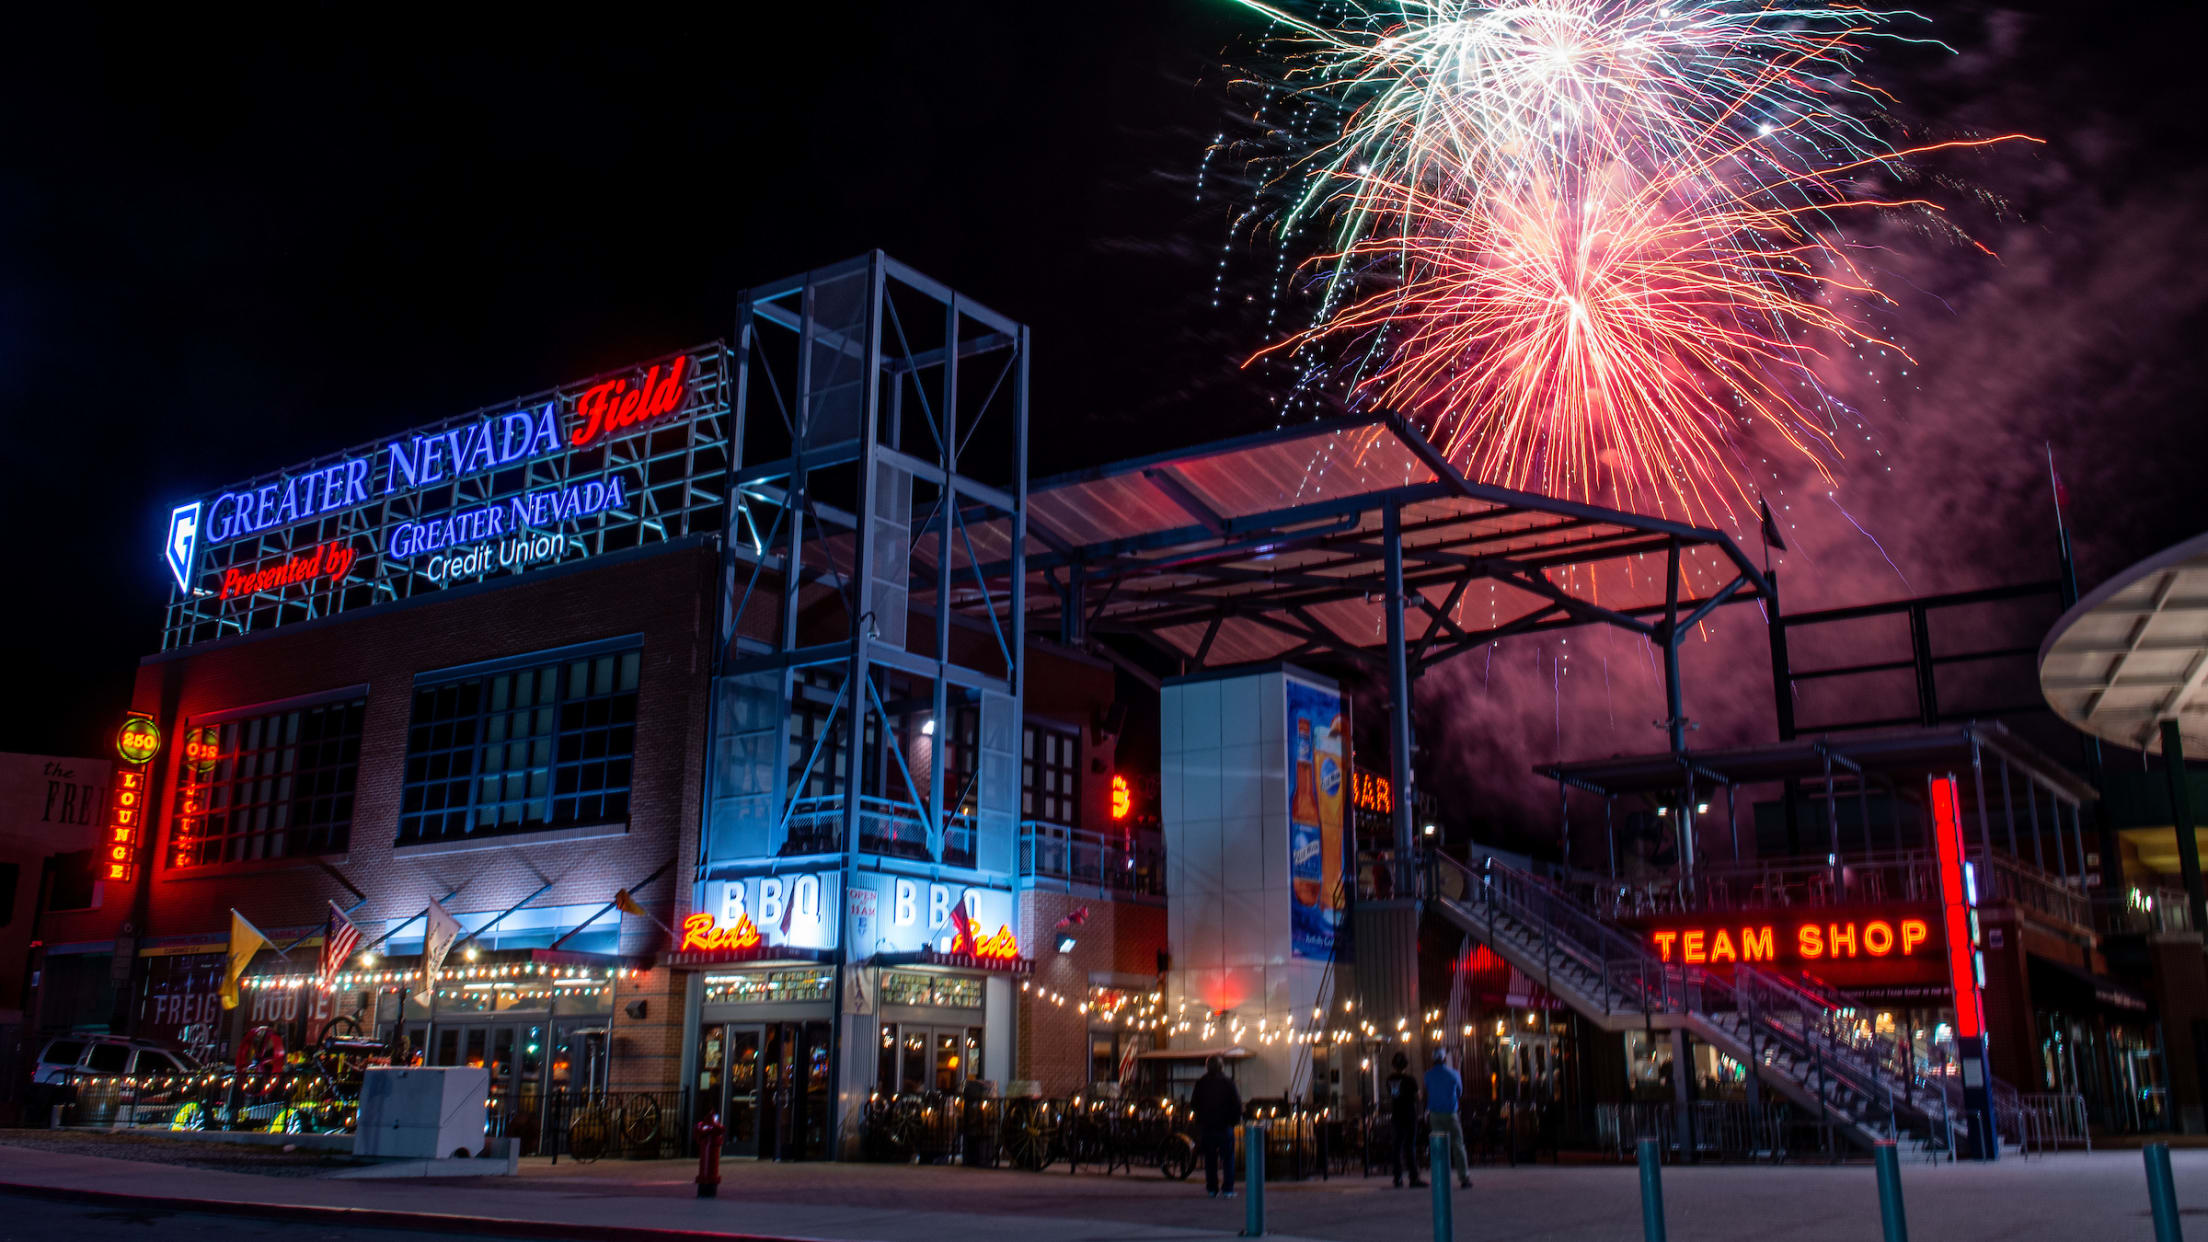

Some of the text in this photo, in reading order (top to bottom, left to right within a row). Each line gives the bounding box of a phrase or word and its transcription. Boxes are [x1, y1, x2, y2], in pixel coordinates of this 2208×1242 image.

[206, 356, 689, 544] GREATER NEVADA Field
[390, 476, 624, 560] GREATER NEVADA
[220, 542, 354, 600] Presented by
[427, 533, 565, 584] Credit Union
[44, 761, 76, 778] the
[110, 774, 136, 879] LOUNGE
[722, 874, 822, 929] BBQ
[849, 889, 877, 901] OPEN
[896, 878, 982, 930] BBQ
[683, 913, 760, 950] Red's
[953, 918, 1018, 959] Red's
[1654, 919, 1927, 964] TEAM SHOP
